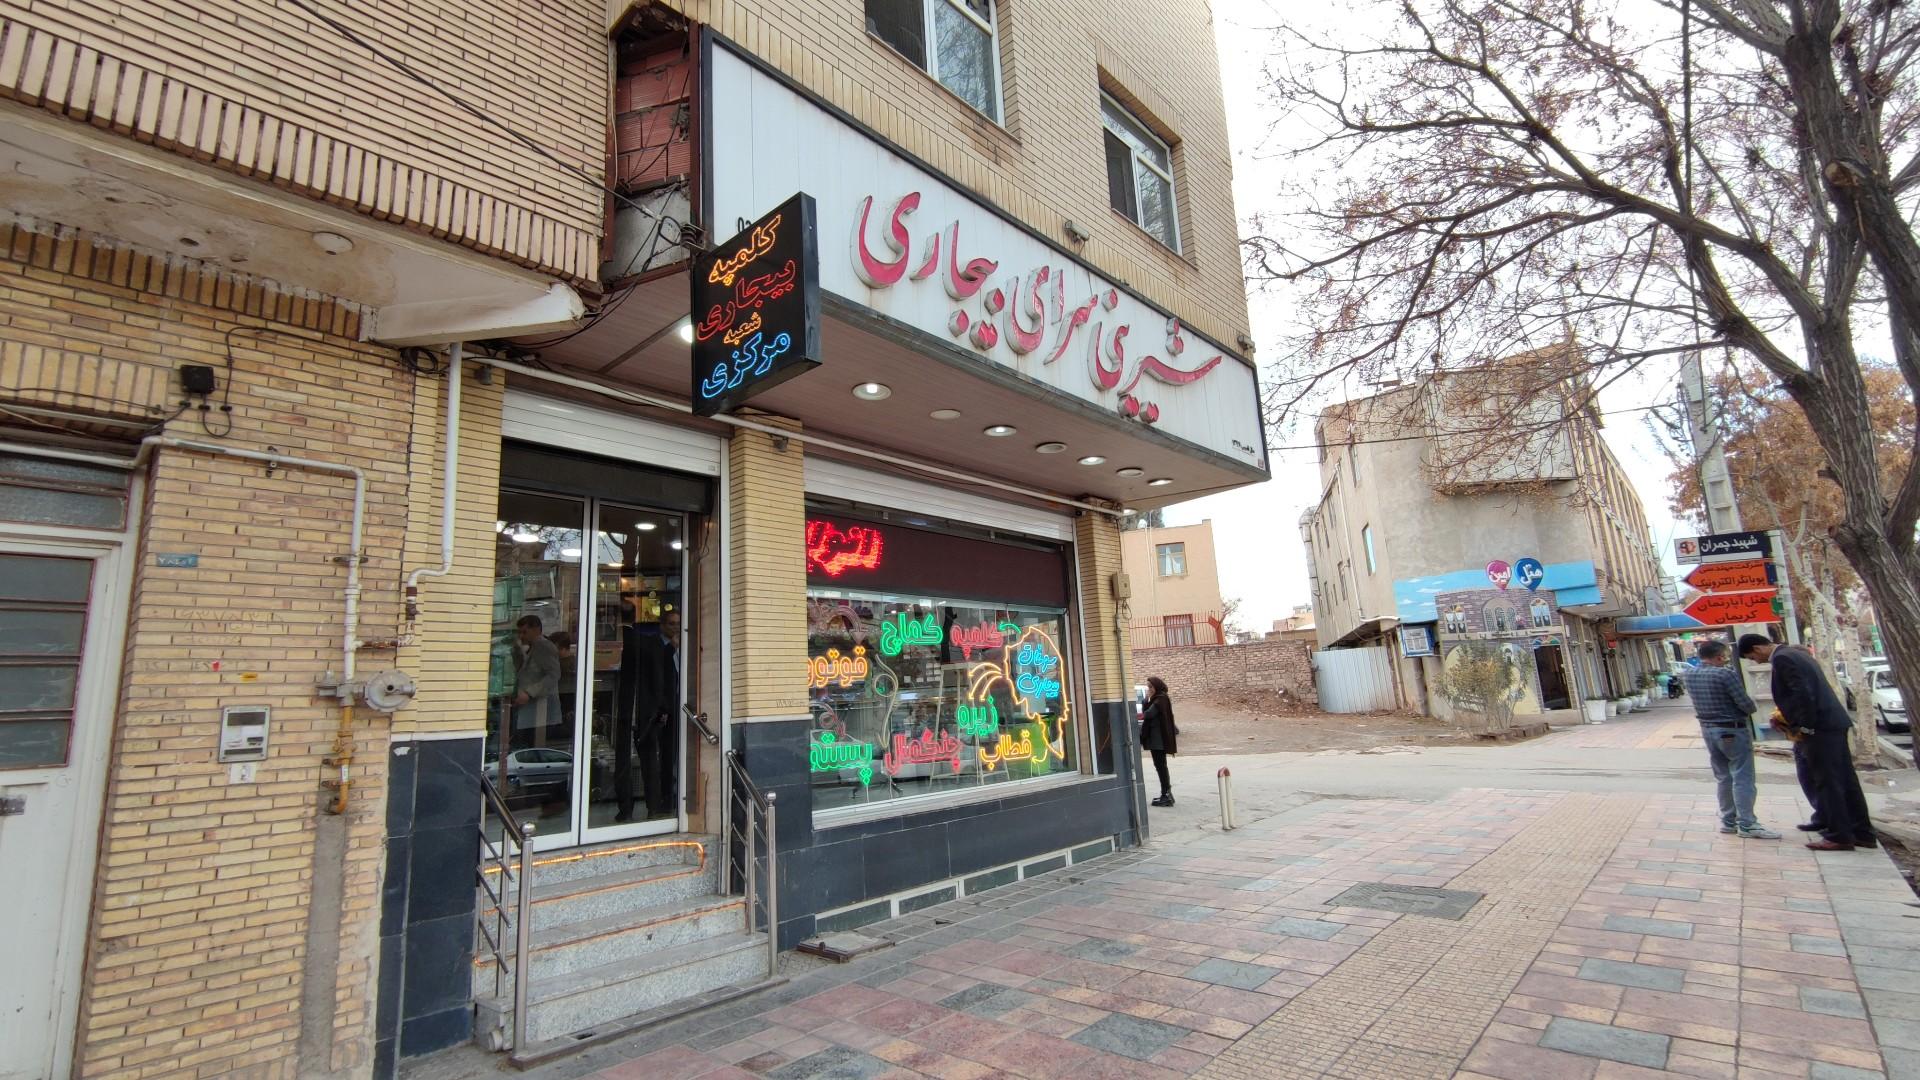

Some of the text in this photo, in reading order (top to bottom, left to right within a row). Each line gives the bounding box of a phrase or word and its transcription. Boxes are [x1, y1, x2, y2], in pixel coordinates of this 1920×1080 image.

[708, 214, 782, 286] کلمپه
[849, 191, 1006, 351] بیجاری
[696, 259, 796, 341] بیجاری
[1003, 265, 1098, 365] سرای
[723, 311, 762, 345] شعبه
[702, 332, 791, 399] مرکزی
[1700, 535, 1758, 552] شهید چمران
[1520, 564, 1543, 586] هتل
[1696, 594, 1770, 612] هتل آپارتمان
[1715, 609, 1759, 625] کریمان
[880, 612, 943, 656] کماچ
[950, 620, 1004, 660] کلمپه
[1017, 644, 1057, 673] سوغات
[957, 695, 999, 736] زیره
[809, 732, 873, 787] پسته
[979, 729, 1033, 771] قطاب
